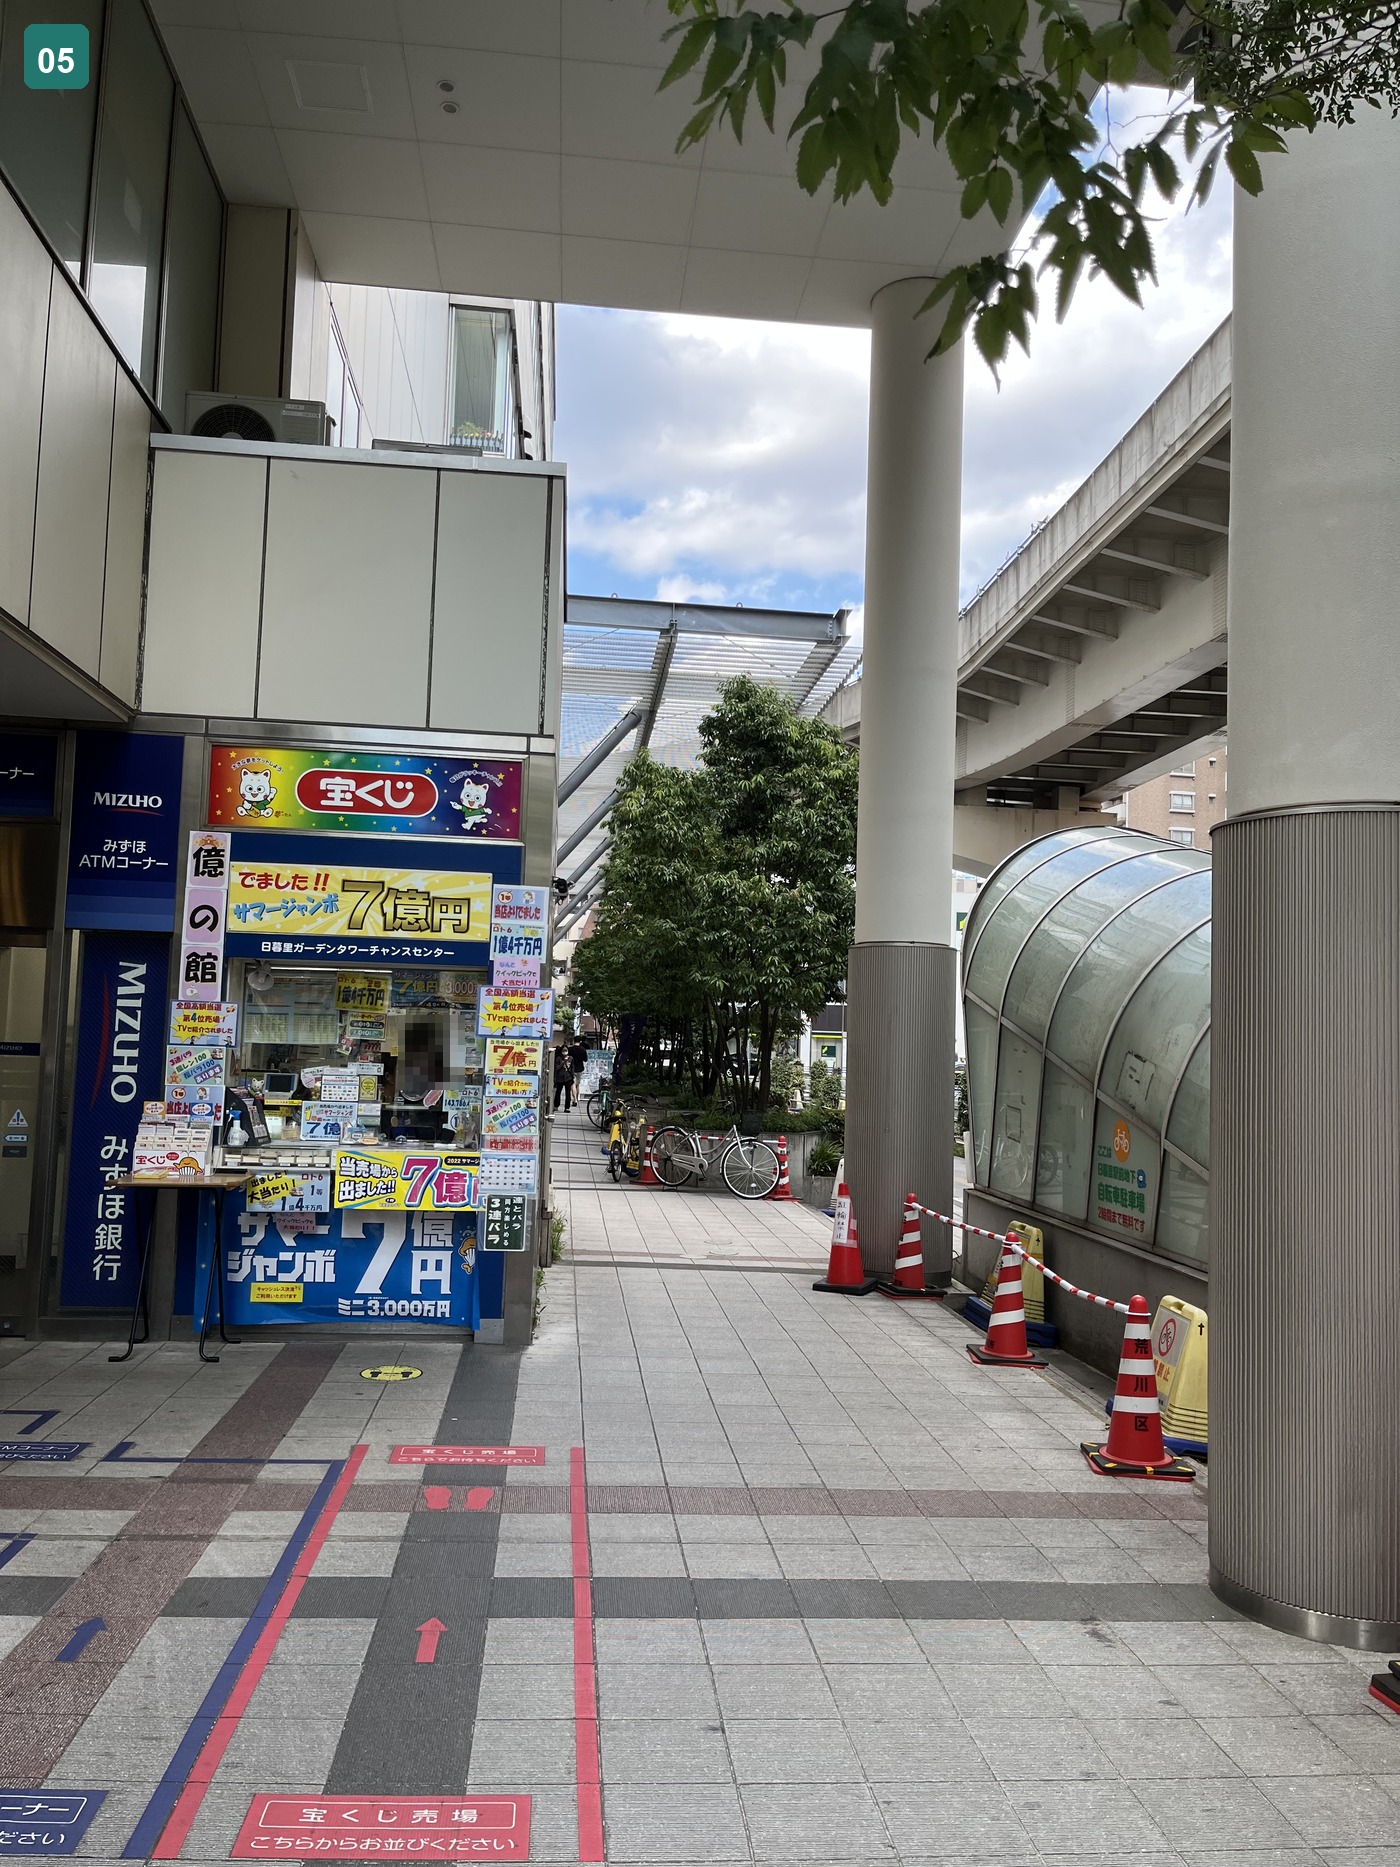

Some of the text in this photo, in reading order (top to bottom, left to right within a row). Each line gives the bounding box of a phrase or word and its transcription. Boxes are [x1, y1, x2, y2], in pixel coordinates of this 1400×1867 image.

[93, 792, 163, 808] MIZUHO
[319, 776, 415, 809] 宝くじ
[103, 839, 147, 853] みずほ
[79, 855, 169, 870] ATMコーナー
[238, 872, 330, 891] でました!!
[184, 846, 226, 985] 億の館
[233, 893, 339, 923] サマージャンボ
[341, 878, 471, 934] 7億円
[494, 904, 541, 920] 当店よりでました
[261, 941, 455, 958] 日暮里ガーデンタワーチャンスセンター
[493, 935, 542, 956] 1億4千万円
[337, 985, 386, 1007] 1億4千万円
[394, 980, 439, 995] 7億円
[445, 981, 479, 995] 3,000
[177, 1025, 233, 1034] TVで紹介されました
[486, 1014, 548, 1025] TVで紹介されました
[110, 961, 147, 1103] MIZUHO
[493, 1045, 537, 1068] 7億円
[136, 1155, 165, 1165] 宝くじ
[339, 1156, 398, 1179] 当売場から
[302, 1173, 324, 1181] ロト6
[402, 1157, 479, 1206] 7億
[248, 1179, 296, 1203] 大当たり!
[310, 1185, 323, 1196] 1等
[338, 1180, 396, 1203] 出ました!!
[1097, 1181, 1145, 1214] 自転車駐車場
[92, 1135, 130, 1281] みずほ銀行
[281, 1196, 323, 1212] 1億4千万円
[487, 1198, 502, 1245] 3連バラ
[227, 1248, 337, 1283] ジャンボ
[1133, 1338, 1150, 1432] 荒川区
[1, 1803, 70, 1815] ーナー
[298, 1808, 479, 1824] 宝くじ売場
[249, 1836, 515, 1851] こちらからお並びください
